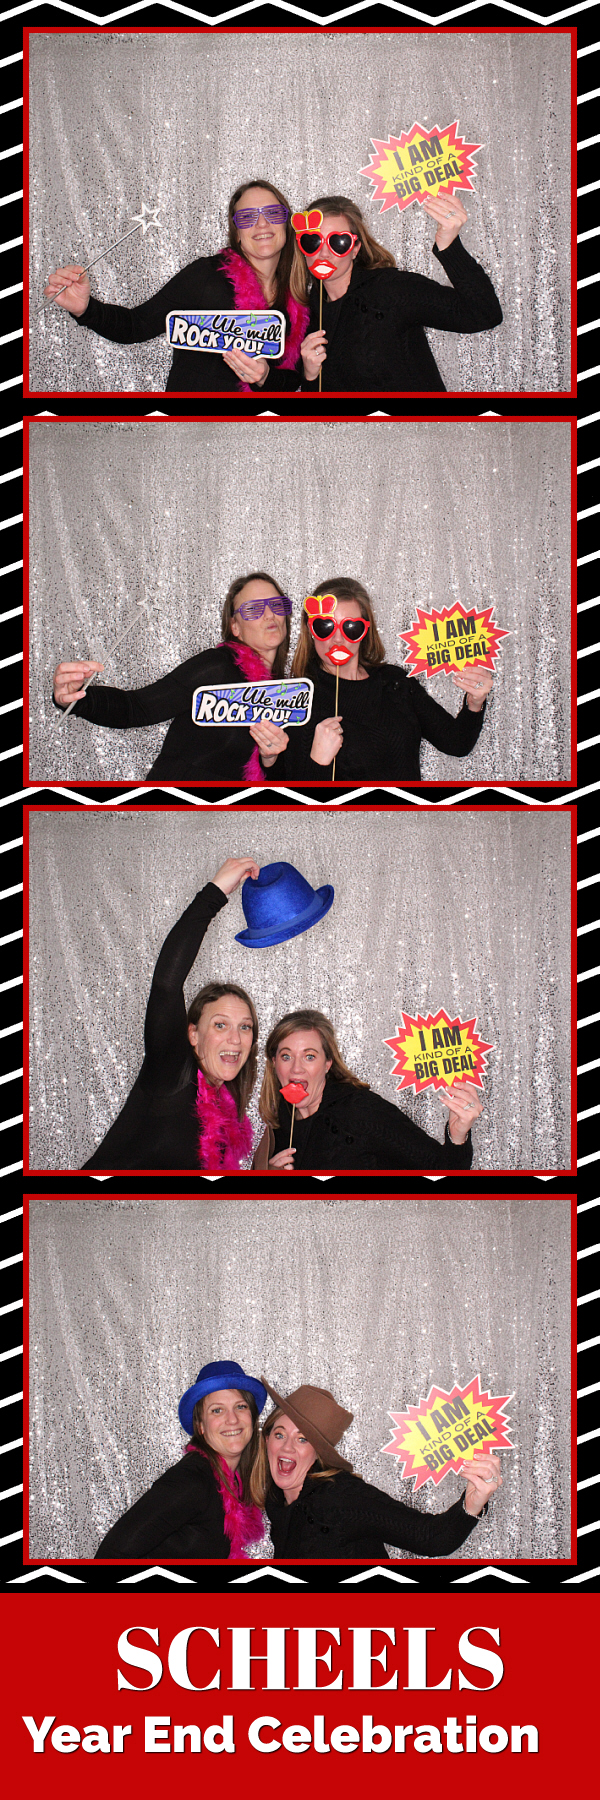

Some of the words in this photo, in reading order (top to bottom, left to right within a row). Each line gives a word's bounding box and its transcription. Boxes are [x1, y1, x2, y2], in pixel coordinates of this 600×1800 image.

[393, 151, 404, 171] I
[408, 135, 443, 166] AM
[392, 166, 423, 182] KIND
[427, 156, 443, 168] OF
[394, 176, 422, 199] BIG
[424, 160, 464, 186] DEAL
[171, 317, 220, 348] ROCK
[223, 335, 264, 354] YOU!
[212, 315, 244, 335] We
[247, 324, 282, 342] will
[432, 623, 439, 641] I
[446, 616, 476, 639] AM
[427, 640, 455, 651] KIND
[459, 636, 475, 644] OF
[427, 649, 451, 666] BIG
[455, 641, 490, 660] DEAL
[197, 692, 250, 722] ROCK
[251, 706, 292, 723] YOU!
[242, 687, 273, 706] We
[276, 692, 309, 708] will
[419, 1031, 426, 1051] I
[432, 1026, 462, 1049] AM
[414, 1051, 442, 1061] KIND
[446, 1048, 461, 1056] OF
[414, 1060, 439, 1079] BIG
[442, 1054, 477, 1074] DEAL
[416, 1421, 431, 1441] I
[430, 1396, 470, 1433] AM
[420, 1432, 451, 1454] KIND
[455, 1417, 471, 1432] OF
[477, 1411, 486, 1420] A
[423, 1444, 455, 1471] BIG
[453, 1418, 497, 1452] DEAL
